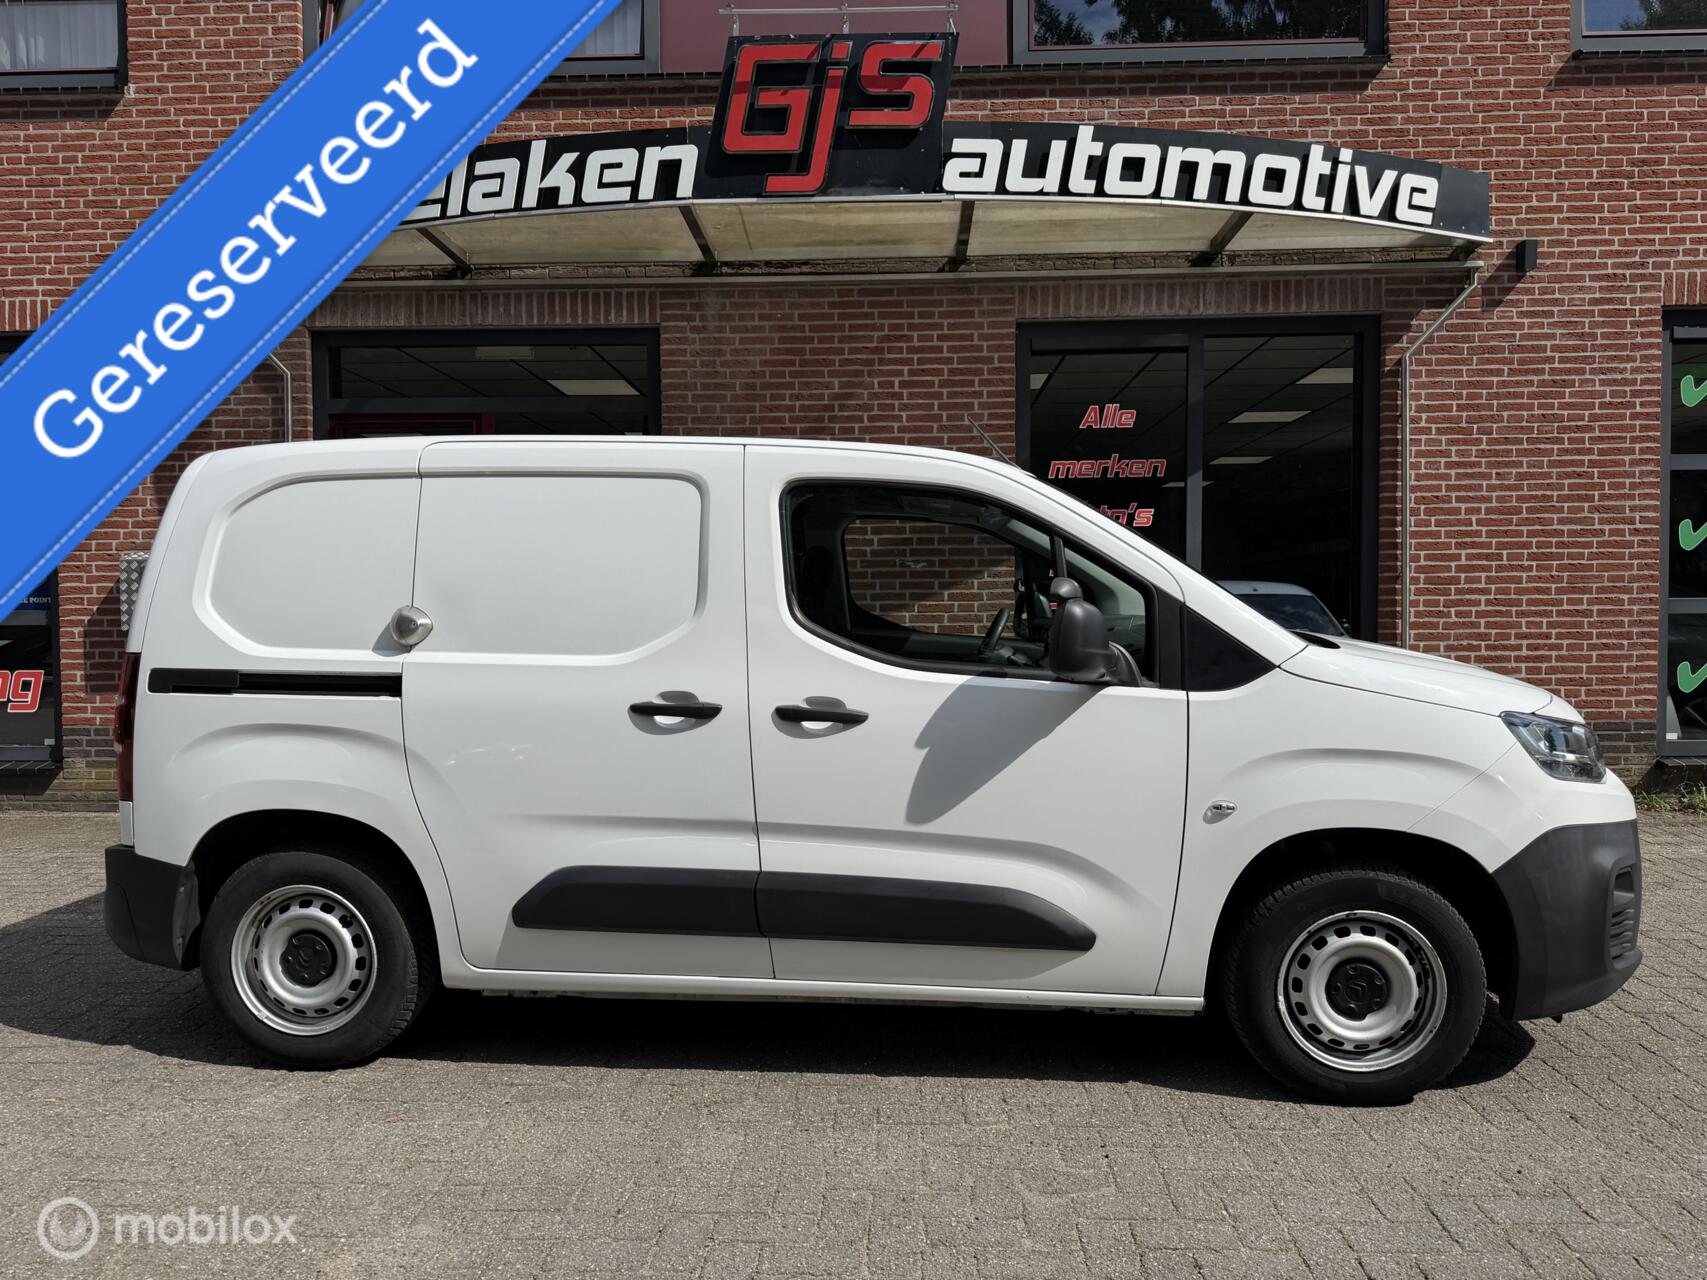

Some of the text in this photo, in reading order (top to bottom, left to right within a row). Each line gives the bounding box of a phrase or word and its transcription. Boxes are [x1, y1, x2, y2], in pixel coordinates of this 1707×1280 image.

[942, 125, 1440, 226] automotive
[1079, 403, 1137, 429] Alle
[1047, 453, 1167, 479] merken
